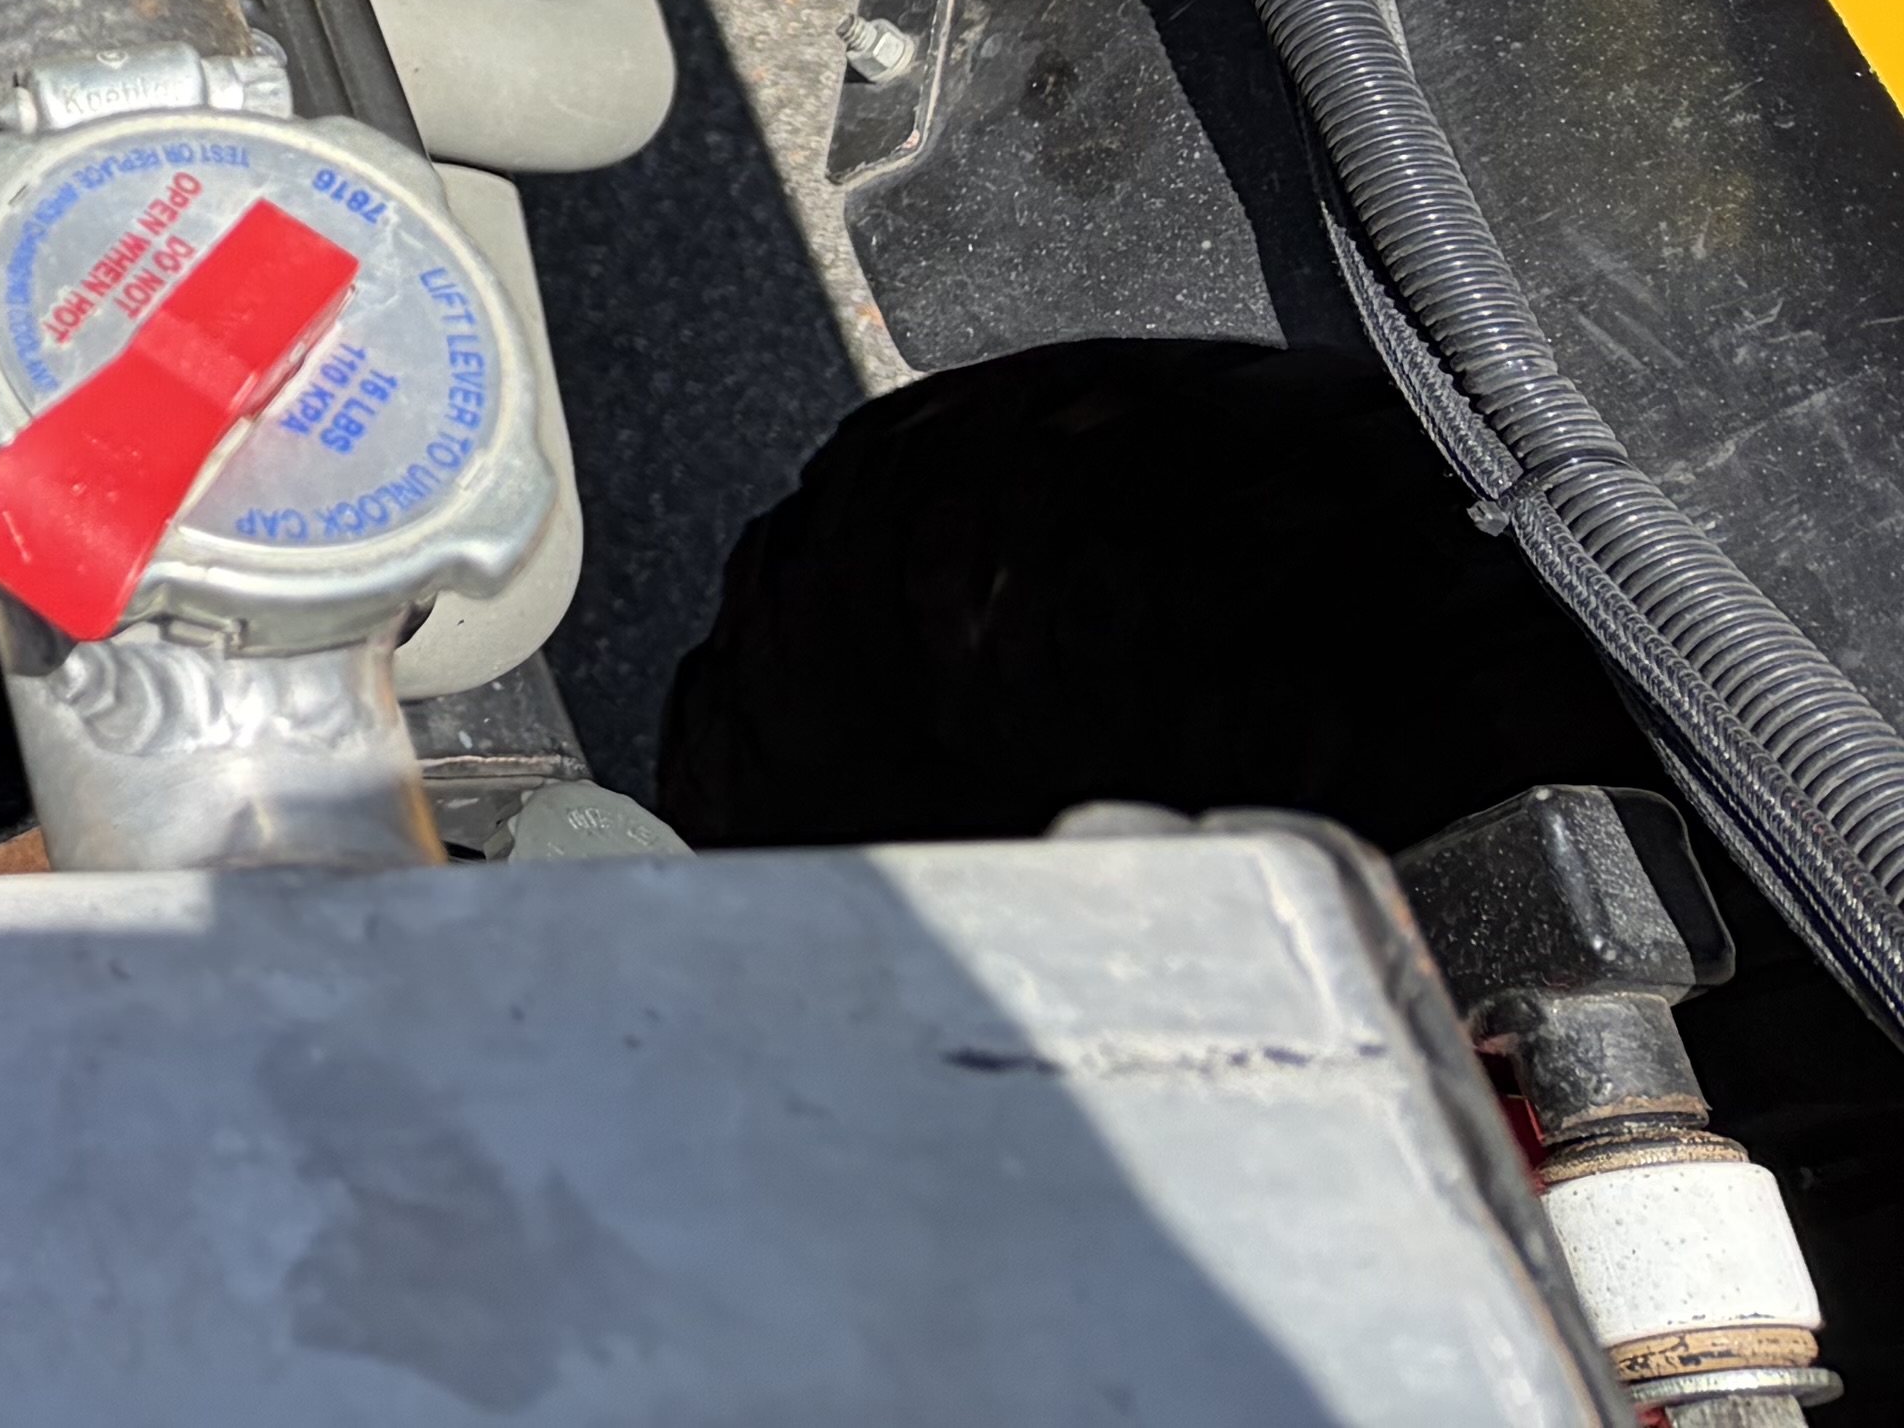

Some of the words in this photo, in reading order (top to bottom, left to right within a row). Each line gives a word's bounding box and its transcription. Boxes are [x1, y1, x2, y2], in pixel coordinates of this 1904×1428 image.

[71, 147, 162, 191] REPLACE
[162, 143, 193, 165] OR
[199, 143, 250, 169] TEST
[137, 170, 204, 237] OPEN
[311, 167, 388, 224] 7816
[80, 231, 152, 297] WHEN
[152, 234, 196, 274] DO
[43, 290, 95, 344] HOT
[113, 267, 166, 321] NOT
[418, 266, 476, 328] LIFT
[319, 341, 367, 387] 110
[359, 368, 400, 403] 16
[446, 333, 487, 430] LEVER
[277, 382, 336, 437] KPA
[319, 399, 376, 455] LBS
[425, 430, 473, 470] TO
[234, 507, 309, 541] CAP
[315, 463, 440, 537] UNLOCK
